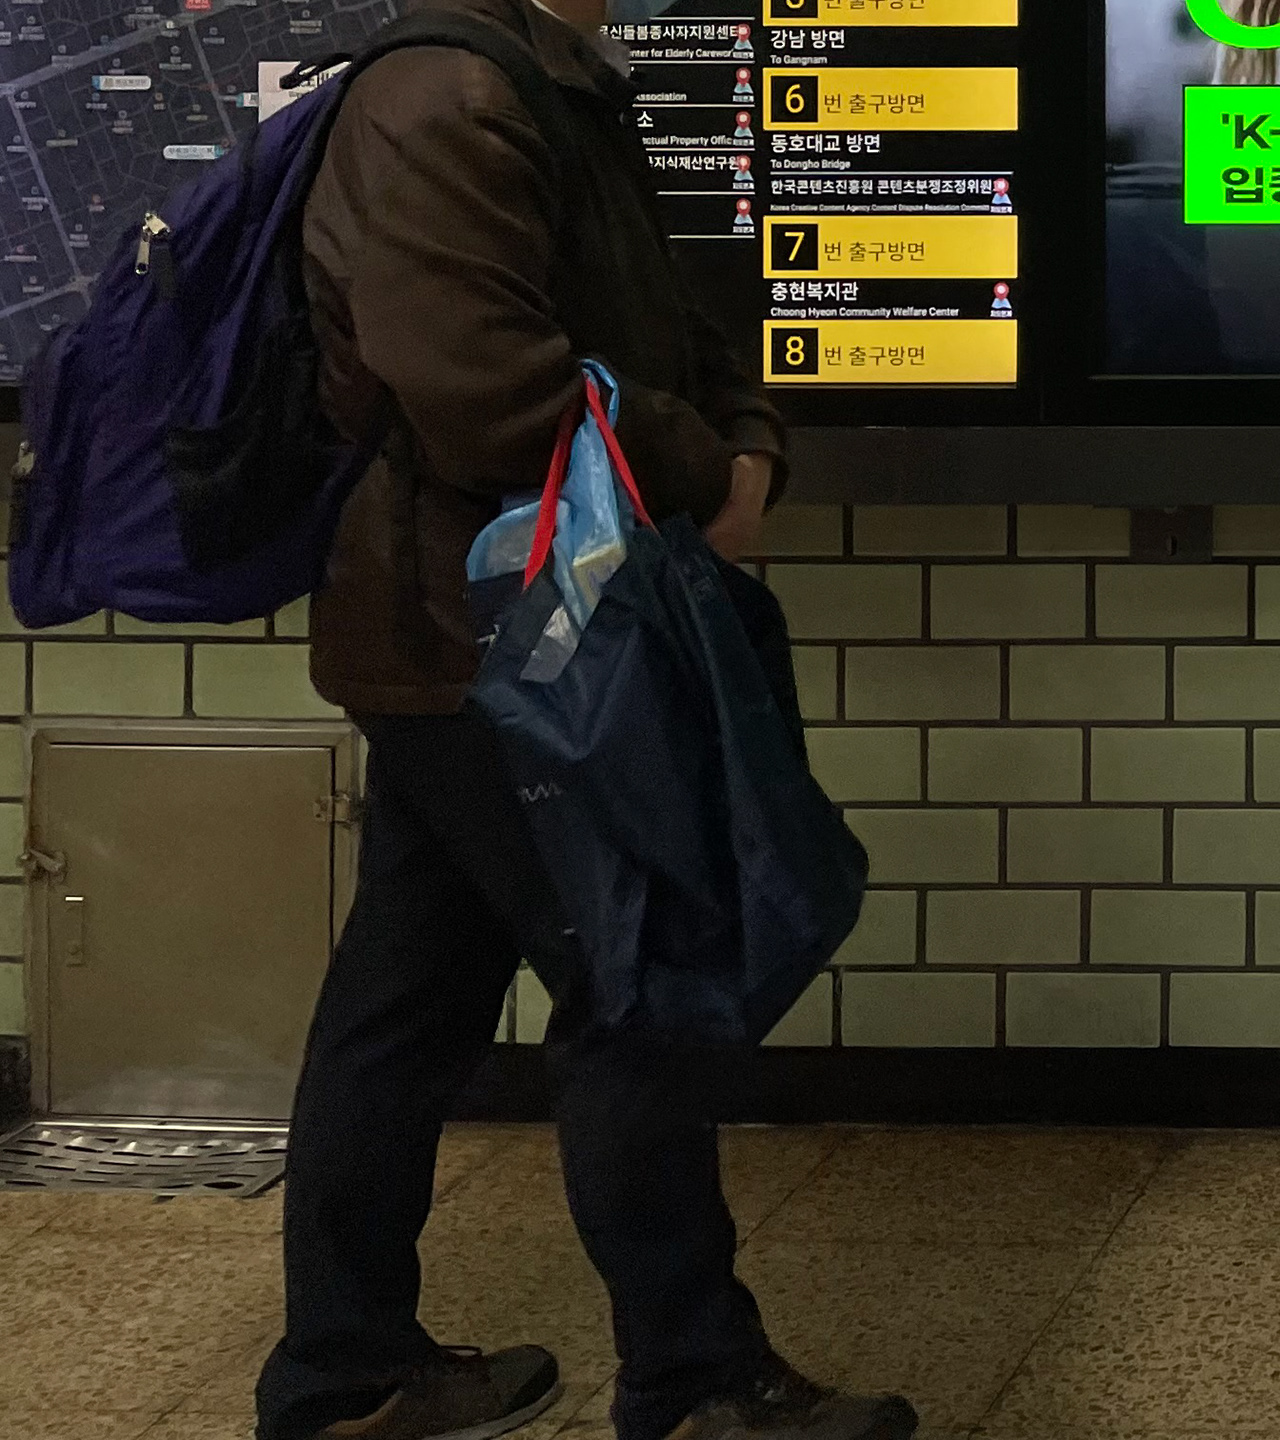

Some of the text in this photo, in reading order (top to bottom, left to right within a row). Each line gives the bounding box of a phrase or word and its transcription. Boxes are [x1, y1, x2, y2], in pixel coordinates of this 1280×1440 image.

[771, 29, 846, 49] 강남 방면
[651, 49, 663, 58] for
[665, 49, 694, 59] Elderly
[695, 49, 733, 58] Carewor
[770, 56, 828, 66] To Gangnam
[785, 84, 925, 114] 6 번 출구방면
[670, 136, 709, 147] Property
[710, 136, 733, 145] Offic
[771, 134, 881, 154] 동호대교 방면
[770, 159, 851, 170] To Dongho Bridge
[771, 179, 873, 195] 한국콘텐츠진흥원
[784, 231, 925, 262] 7 번 출구방면
[771, 282, 859, 301] 충현복지관
[770, 307, 959, 318] Choong Hyeon Community Welfare Center
[785, 335, 925, 366] 8 번 출구방면
